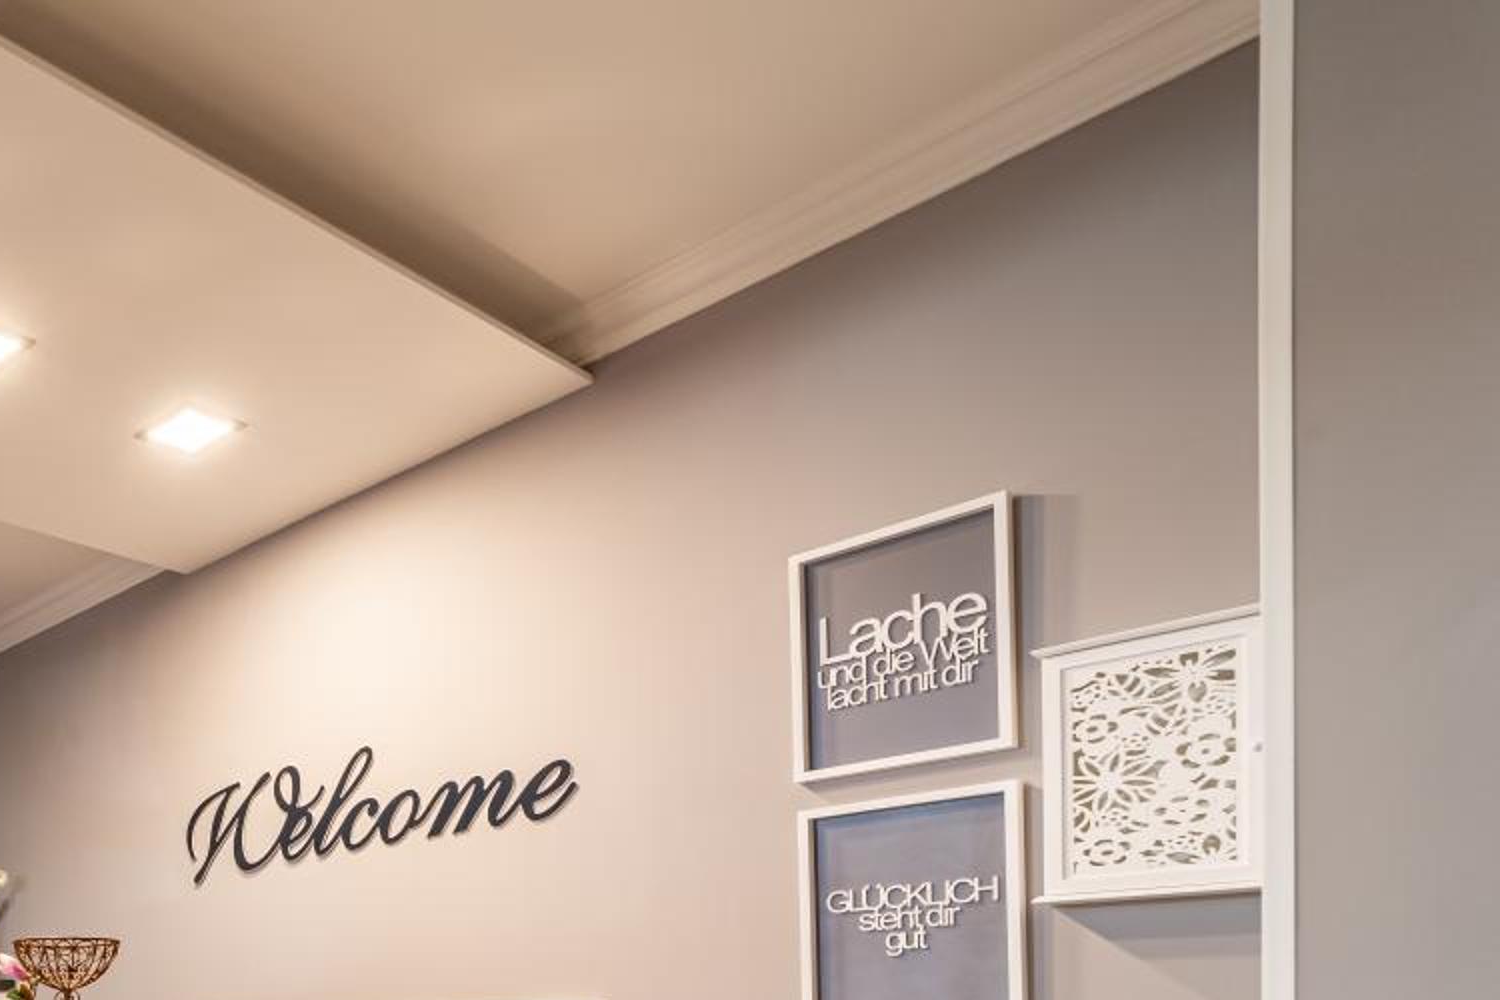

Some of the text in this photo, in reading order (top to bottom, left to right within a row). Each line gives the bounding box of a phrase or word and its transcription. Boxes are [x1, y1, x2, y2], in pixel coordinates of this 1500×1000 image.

[817, 626, 989, 689] und die Welt
[819, 592, 988, 667] Lache
[827, 655, 979, 711] lacht mit dir
[185, 745, 579, 886] Welcome
[826, 875, 999, 914] GLÜCKLICH
[858, 902, 961, 932] steht dir
[885, 926, 928, 957] gut
